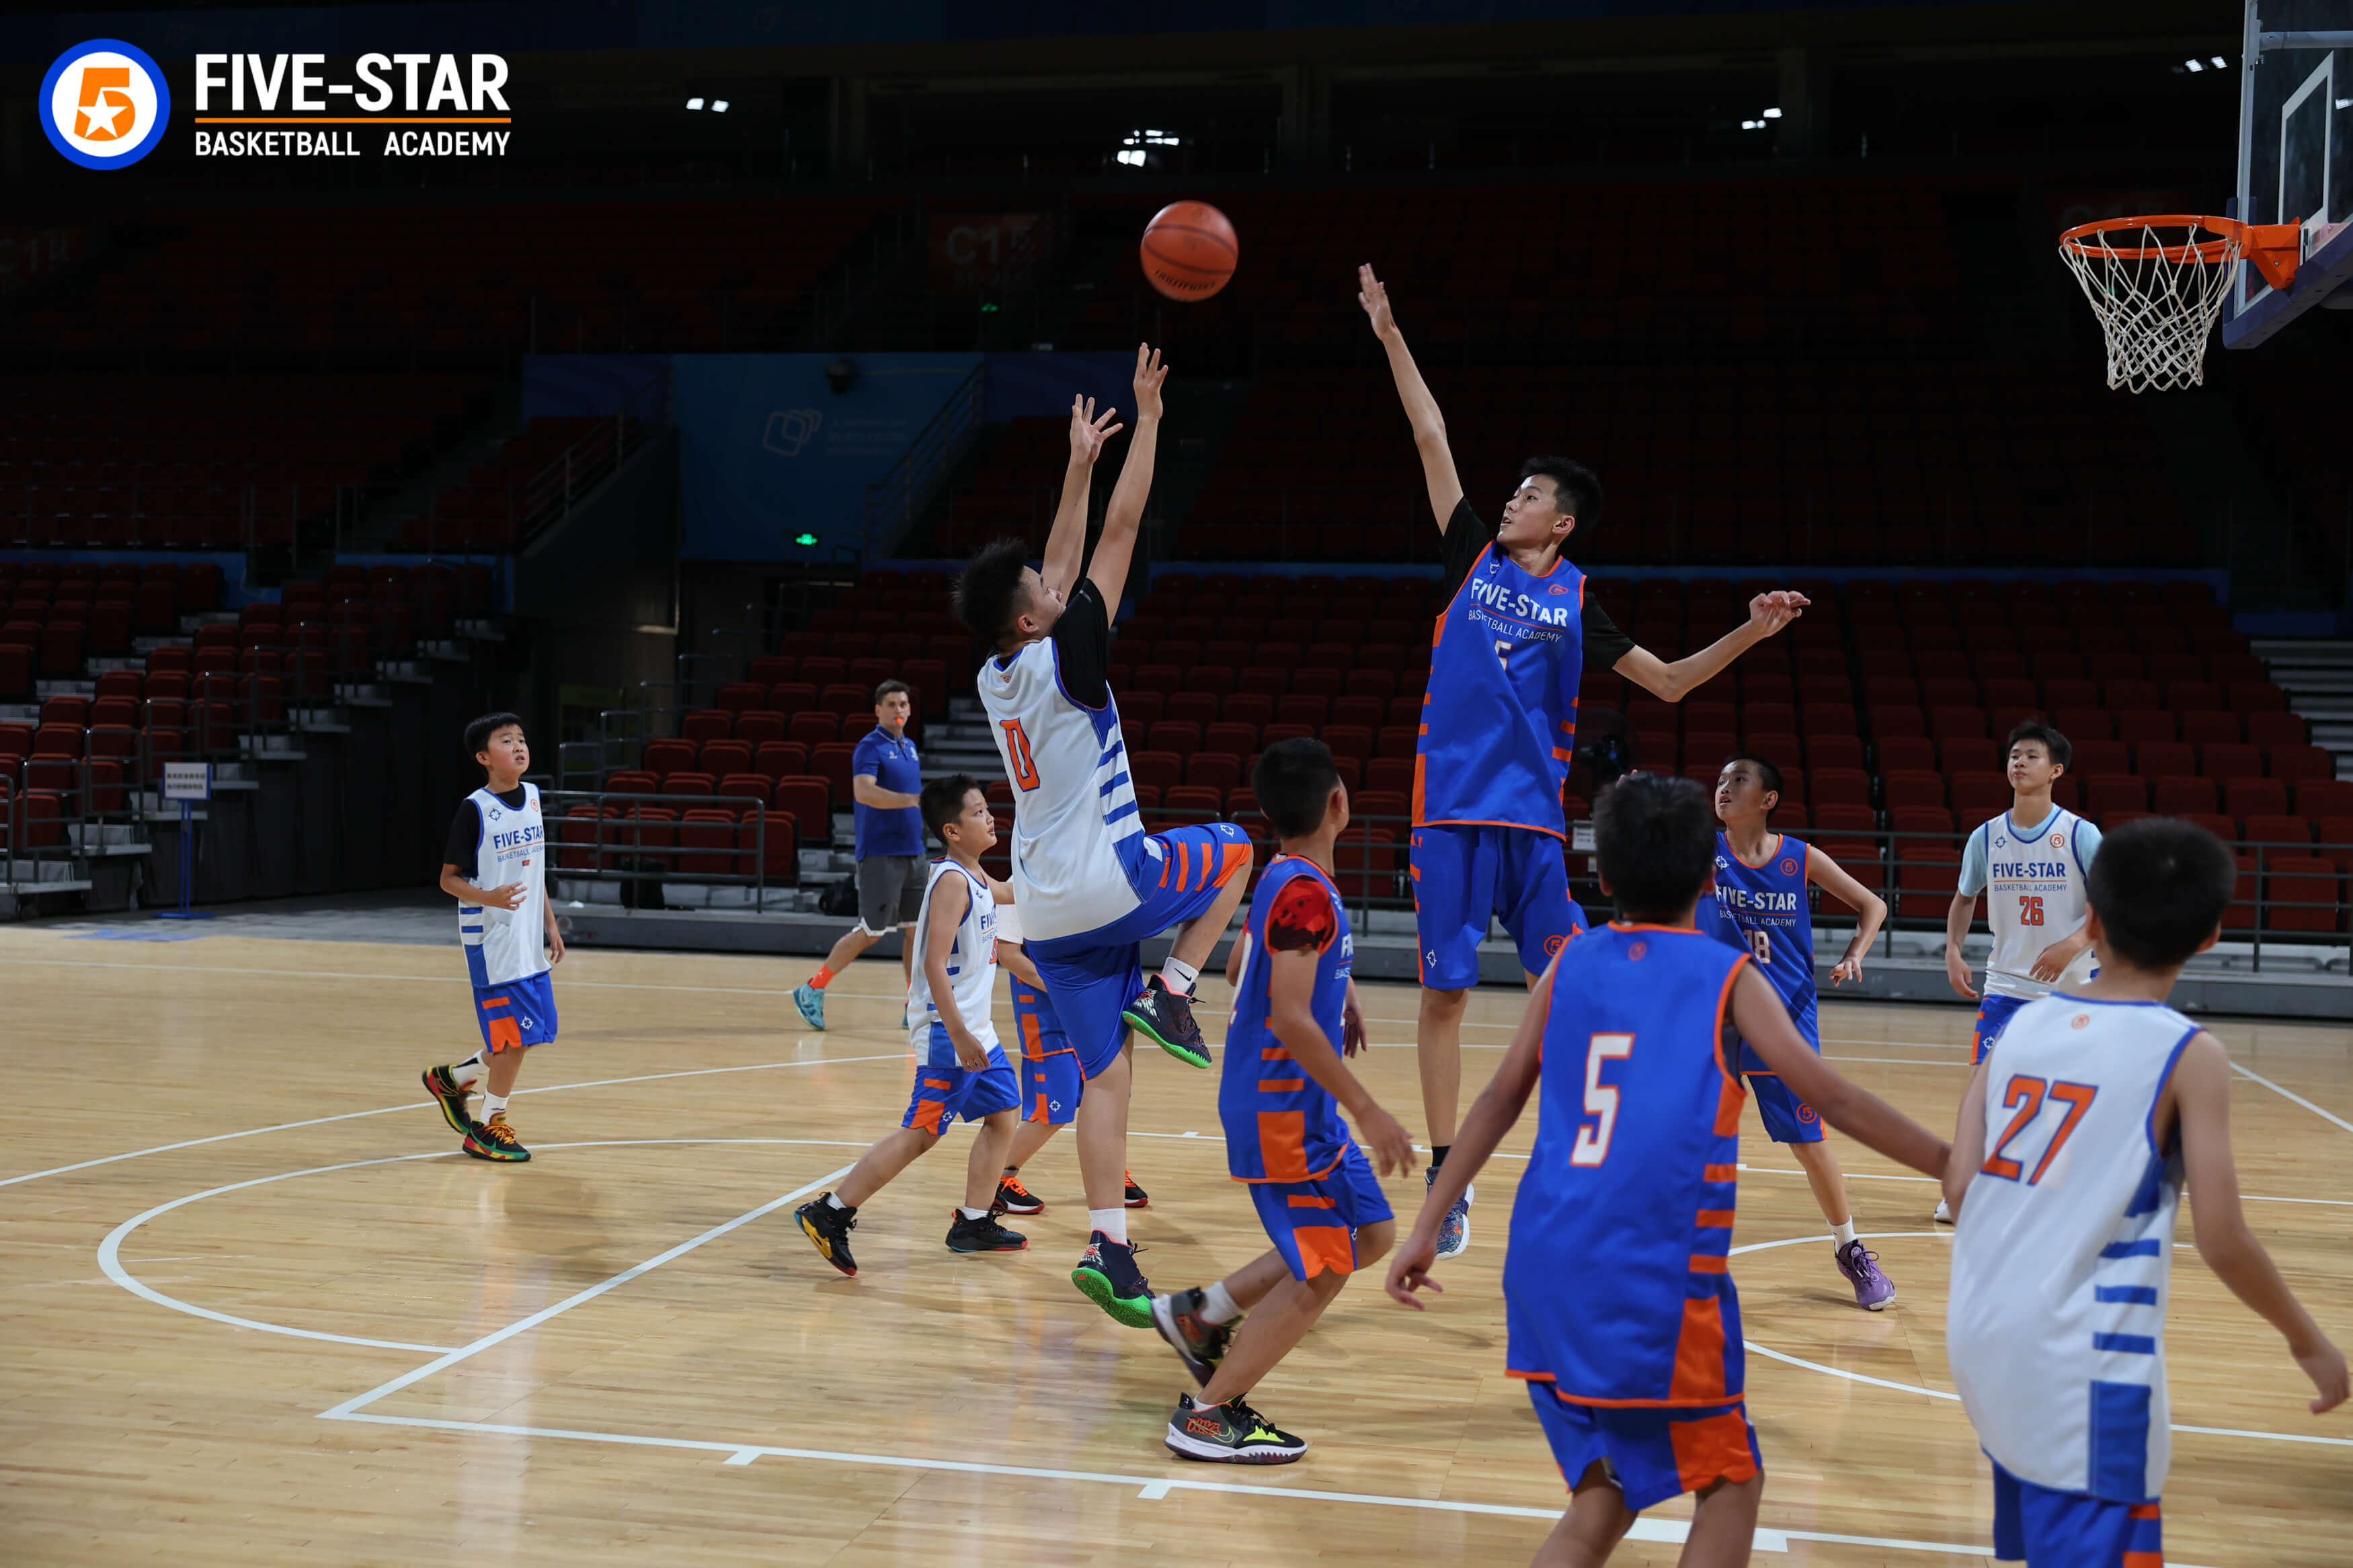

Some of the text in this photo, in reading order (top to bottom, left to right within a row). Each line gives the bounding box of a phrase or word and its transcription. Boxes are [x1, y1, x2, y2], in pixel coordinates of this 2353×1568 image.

[1471, 578, 1568, 627] FIVE-STAR
[1515, 627, 1562, 643] ACADEMY
[1993, 862, 2067, 878] FIVE-STAR
[1715, 884, 1797, 911] FIVE-STAR
[1994, 884, 2067, 892] BASKETBALL ACADEMY
[1761, 917, 1797, 927] ACADEMY
[2019, 895, 2044, 926] 26
[1743, 929, 1771, 964] 18
[1570, 1032, 1636, 1168] 5
[1979, 1073, 2099, 1187] 27
